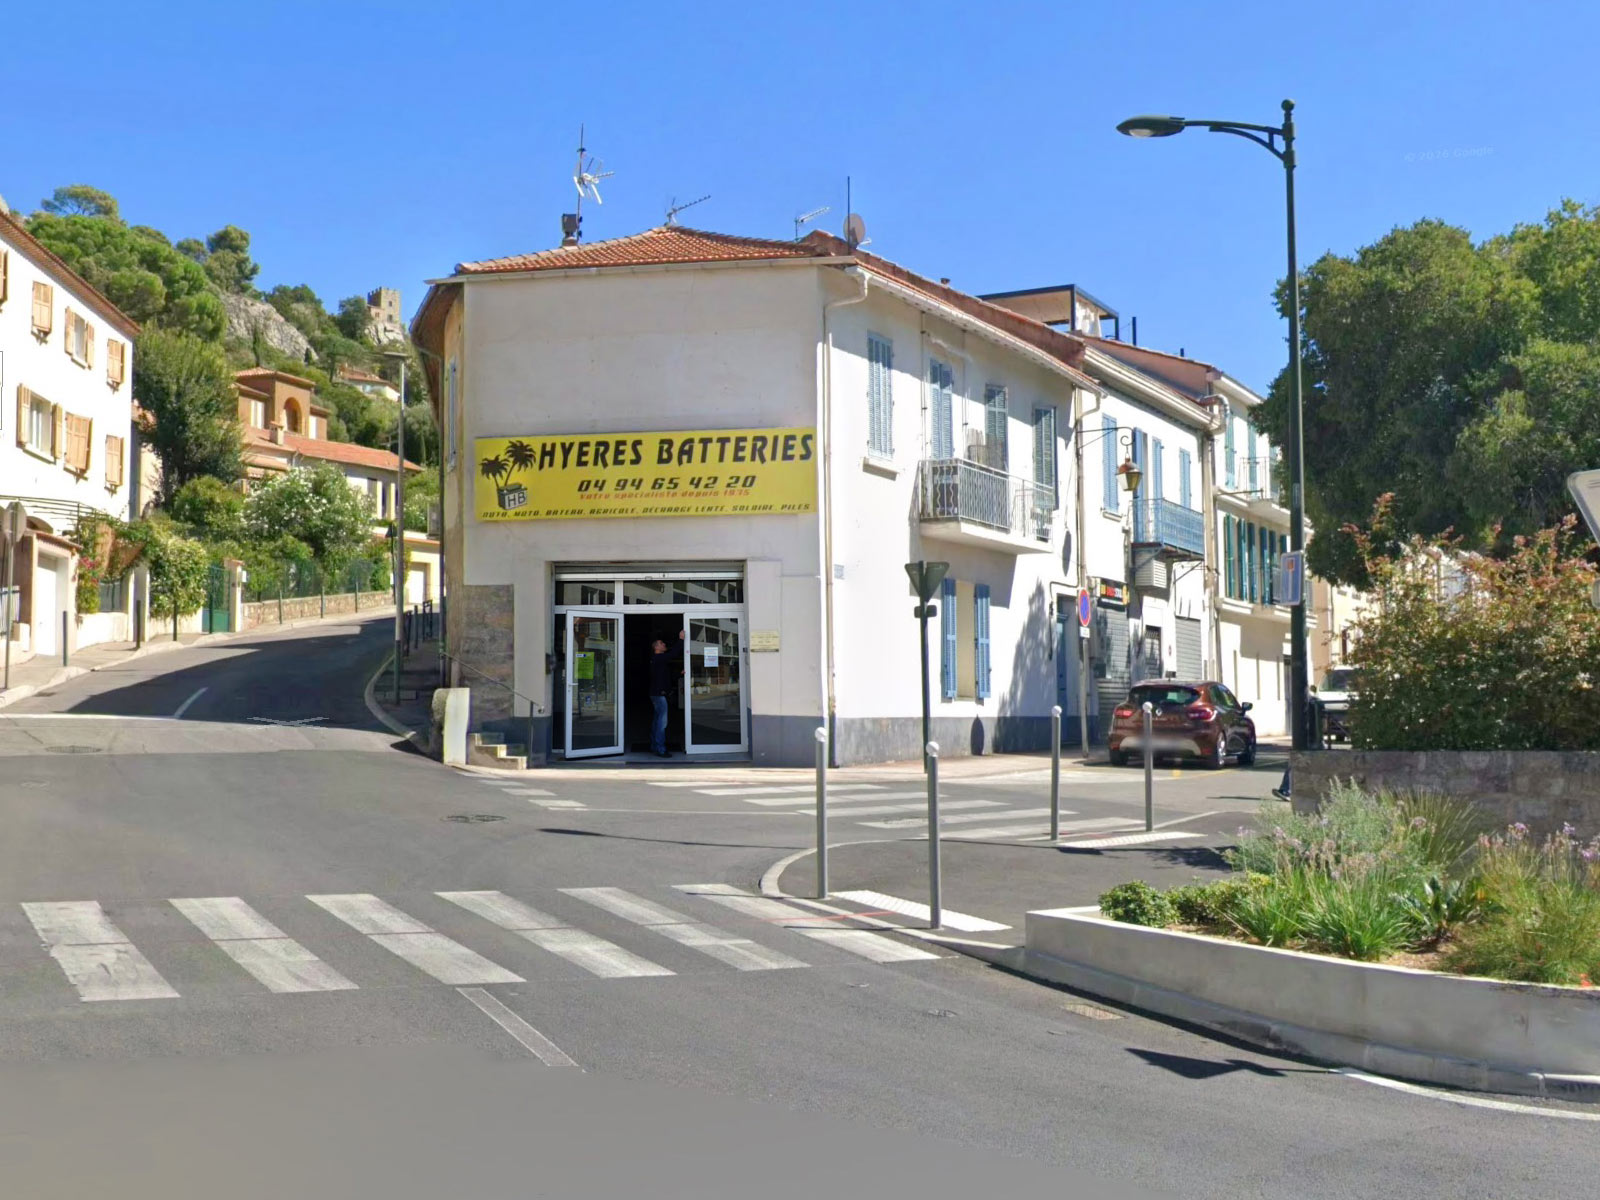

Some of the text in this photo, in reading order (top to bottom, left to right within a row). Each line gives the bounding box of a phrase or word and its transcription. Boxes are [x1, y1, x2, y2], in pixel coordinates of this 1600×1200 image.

[539, 434, 813, 471] HYERES BATTERIES
[578, 475, 757, 493] 04 94 65 42 20
[507, 492, 527, 507] HB
